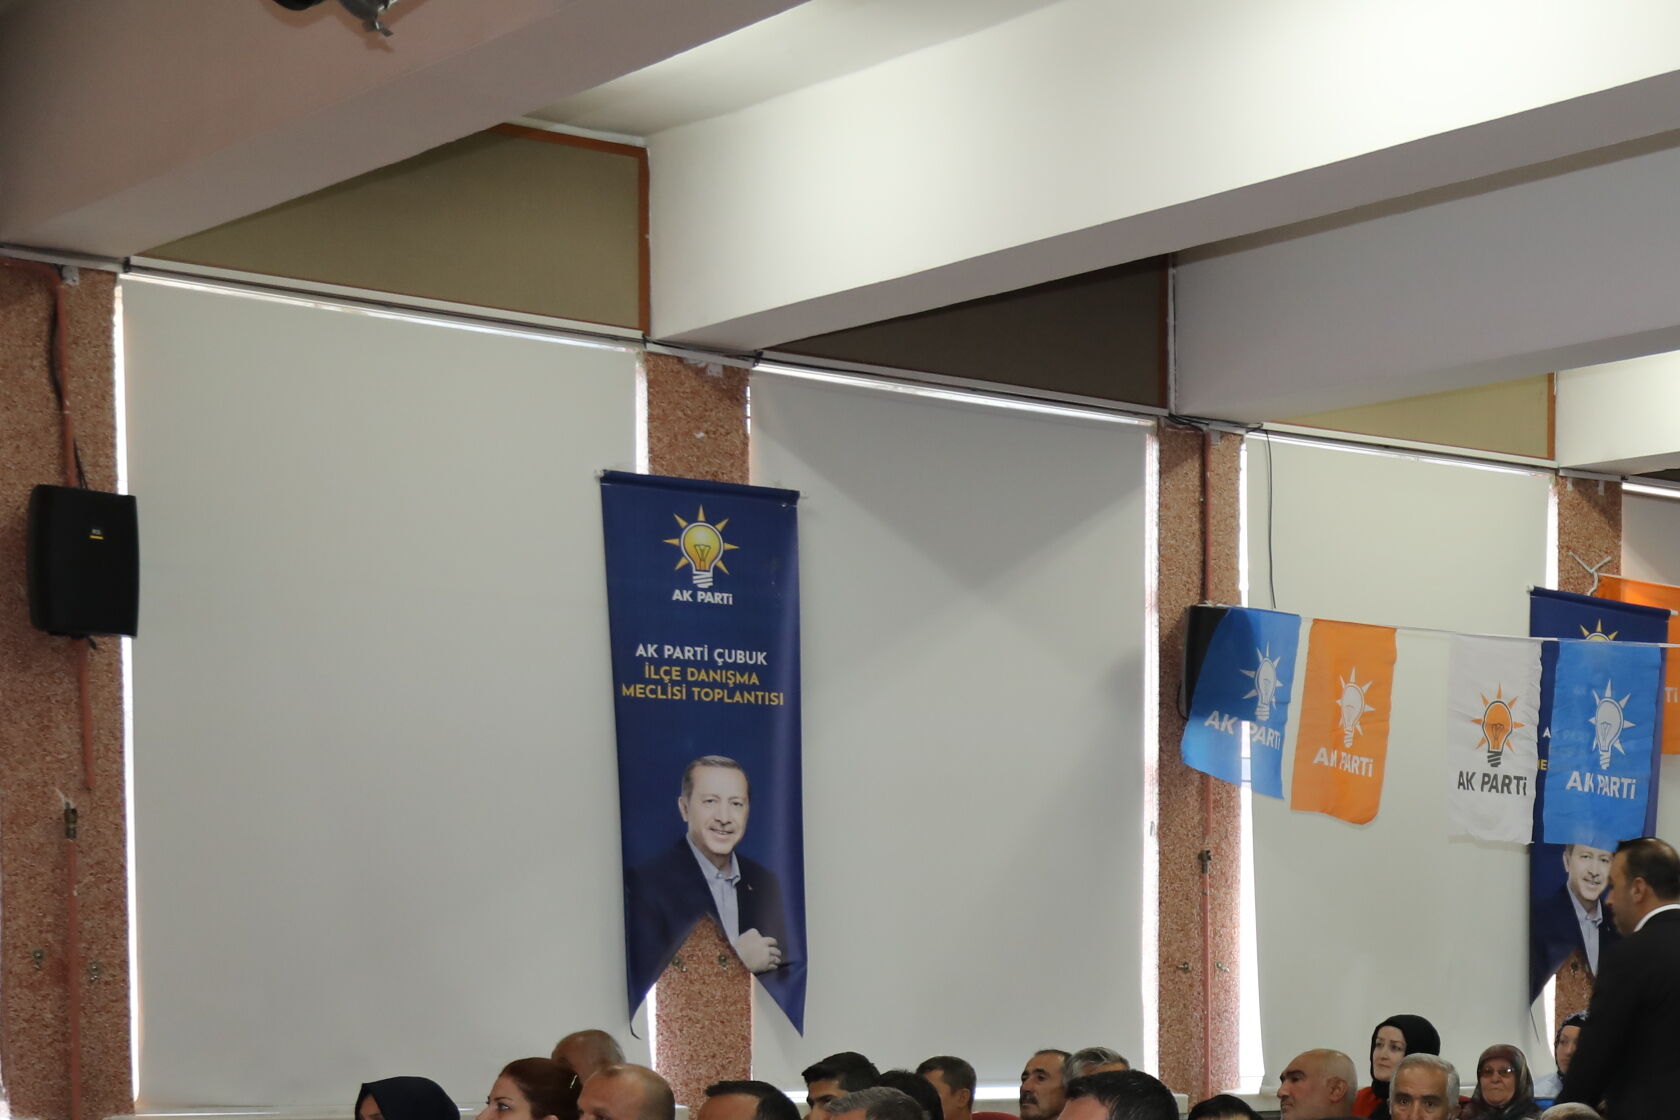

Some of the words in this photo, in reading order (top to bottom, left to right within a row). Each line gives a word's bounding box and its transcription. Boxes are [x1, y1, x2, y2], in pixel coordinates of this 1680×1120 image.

[672, 589, 693, 602] AK
[635, 643, 659, 659] AK
[663, 645, 708, 662] PARTİ
[714, 649, 768, 665] ÇUBUK
[645, 662, 681, 681] İLÇE
[687, 668, 760, 688] DANIŞMA
[622, 682, 687, 700] MECLİSİ
[692, 687, 784, 706] TOPLANTISI
[1204, 710, 1239, 735] AK
[1313, 747, 1337, 767] AK
[1457, 770, 1475, 793] AK
[1565, 771, 1595, 793] AK
